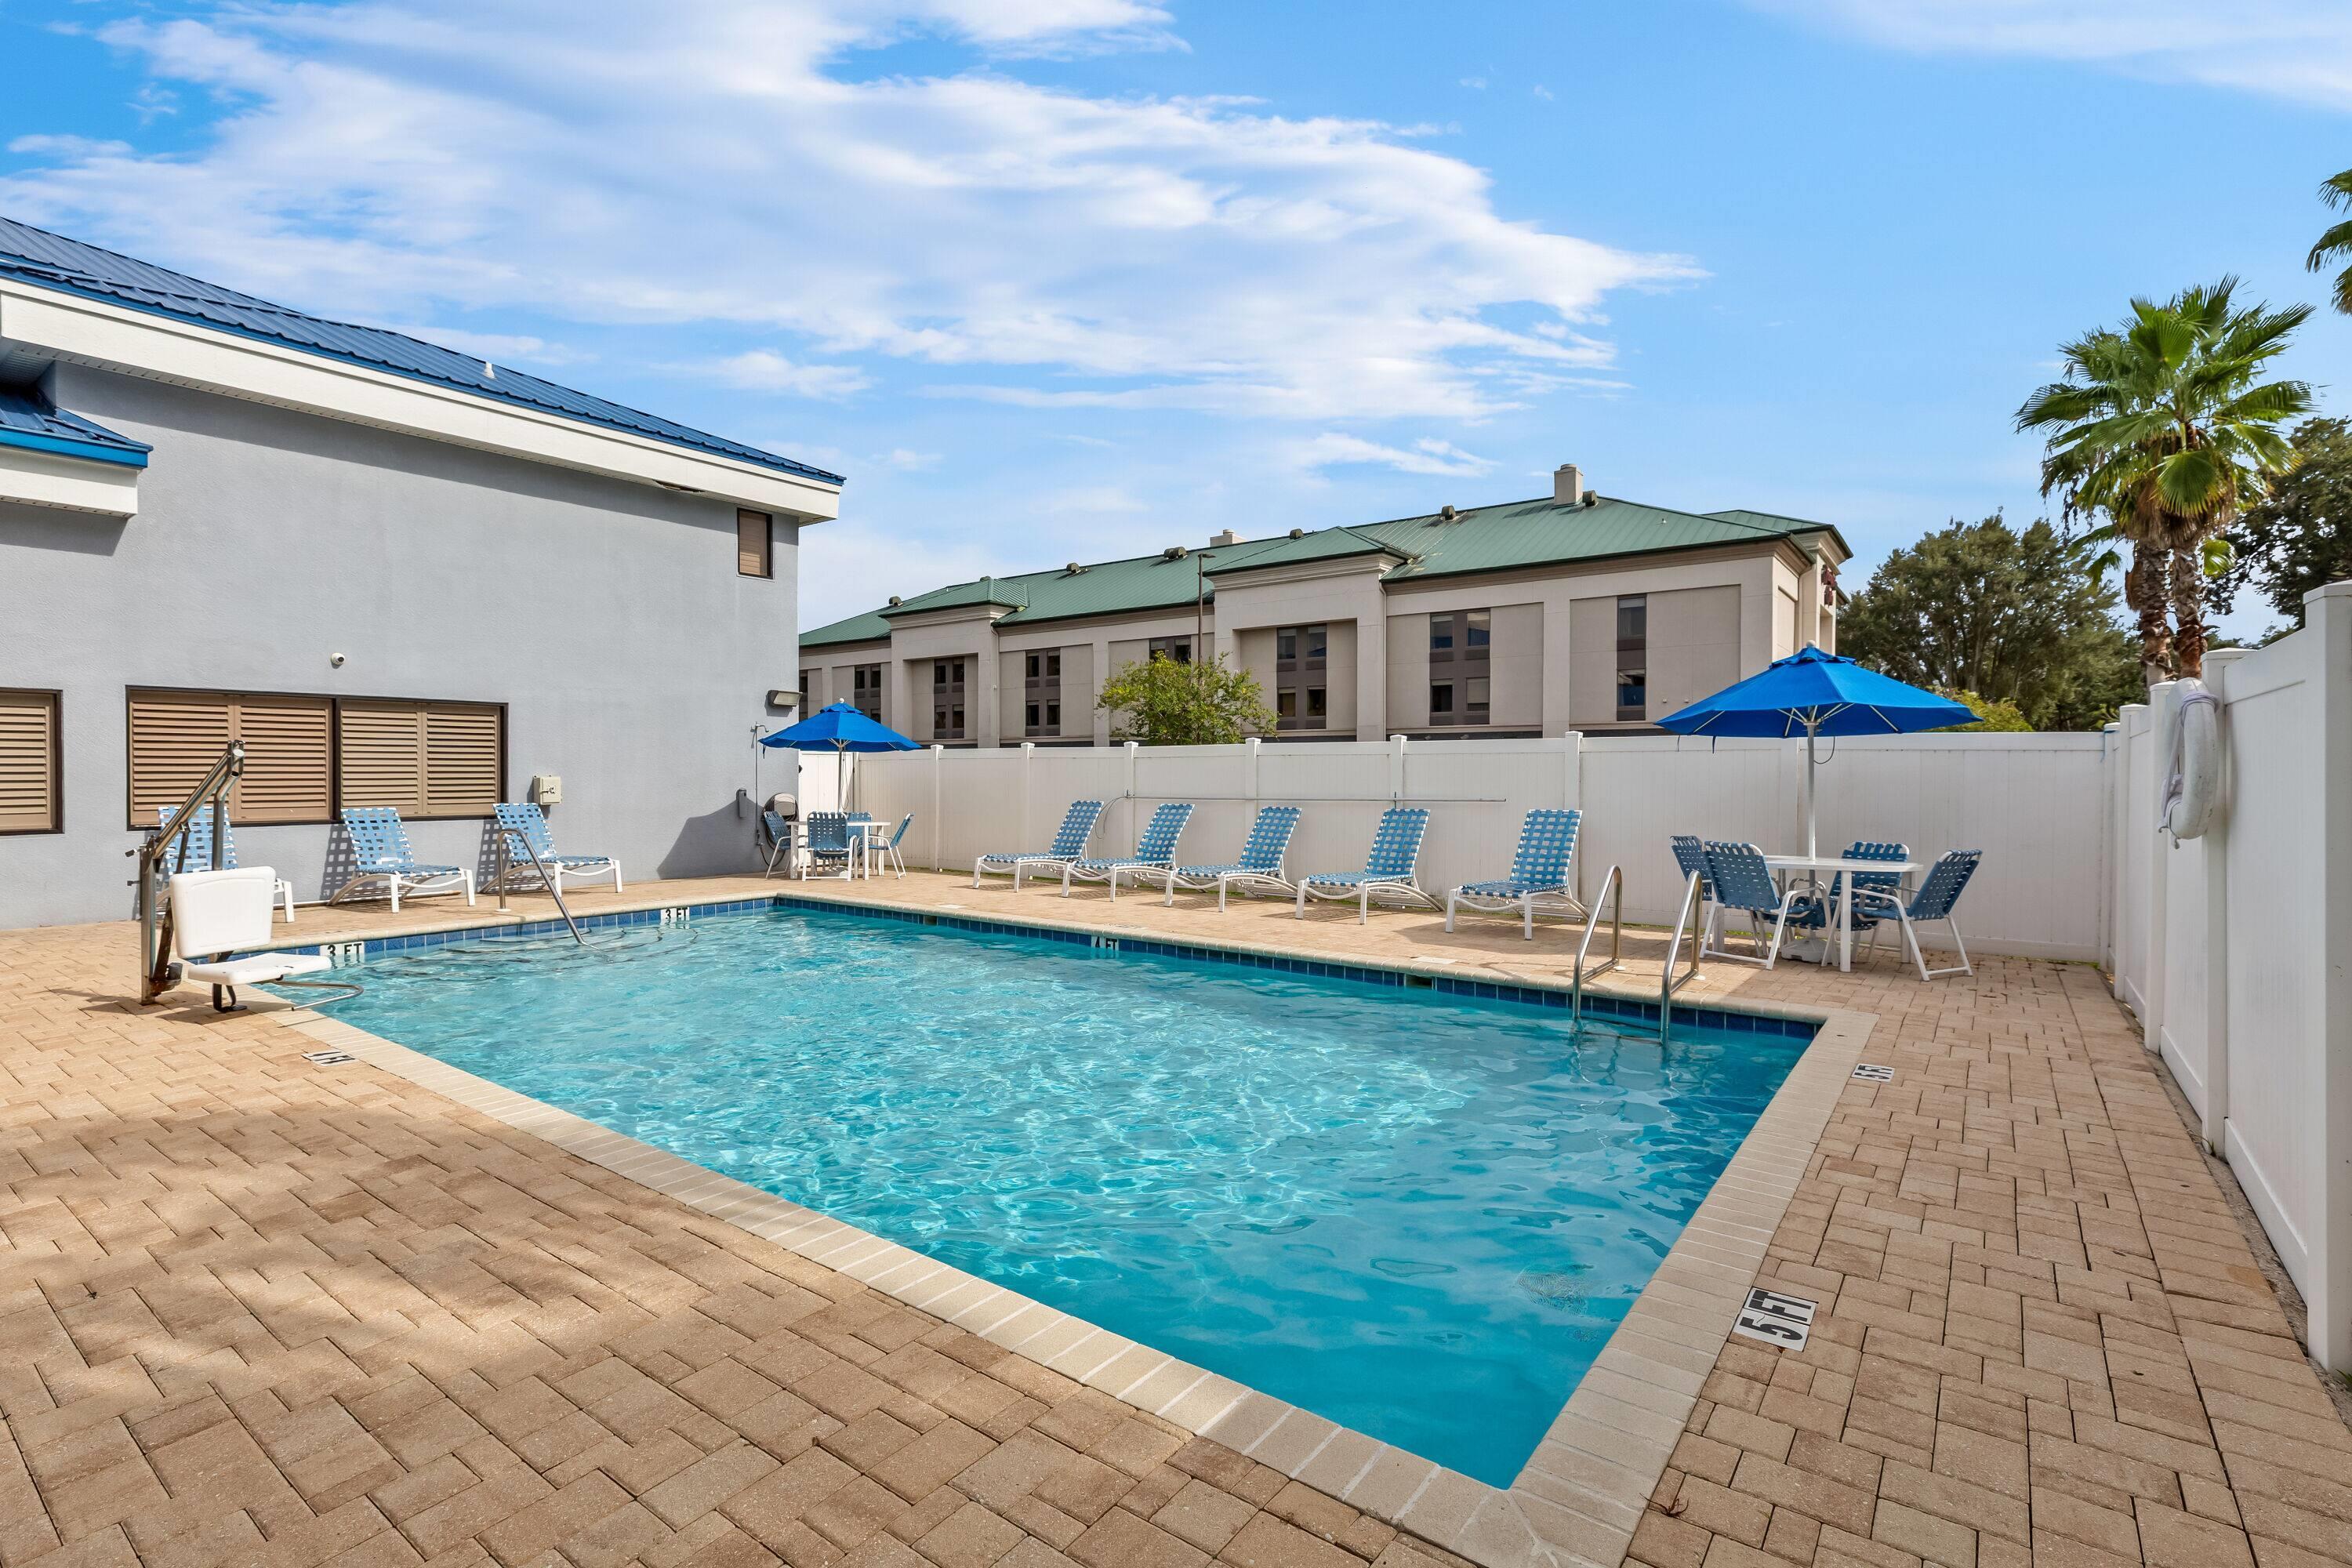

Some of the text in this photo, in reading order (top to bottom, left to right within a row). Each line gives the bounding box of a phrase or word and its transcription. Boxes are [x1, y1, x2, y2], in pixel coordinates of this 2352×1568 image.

[665, 907, 688, 920] 3 FT
[327, 942, 362, 957] 3 FT
[1105, 937, 1118, 950] FT
[1739, 1289, 1812, 1341] 5 FT
